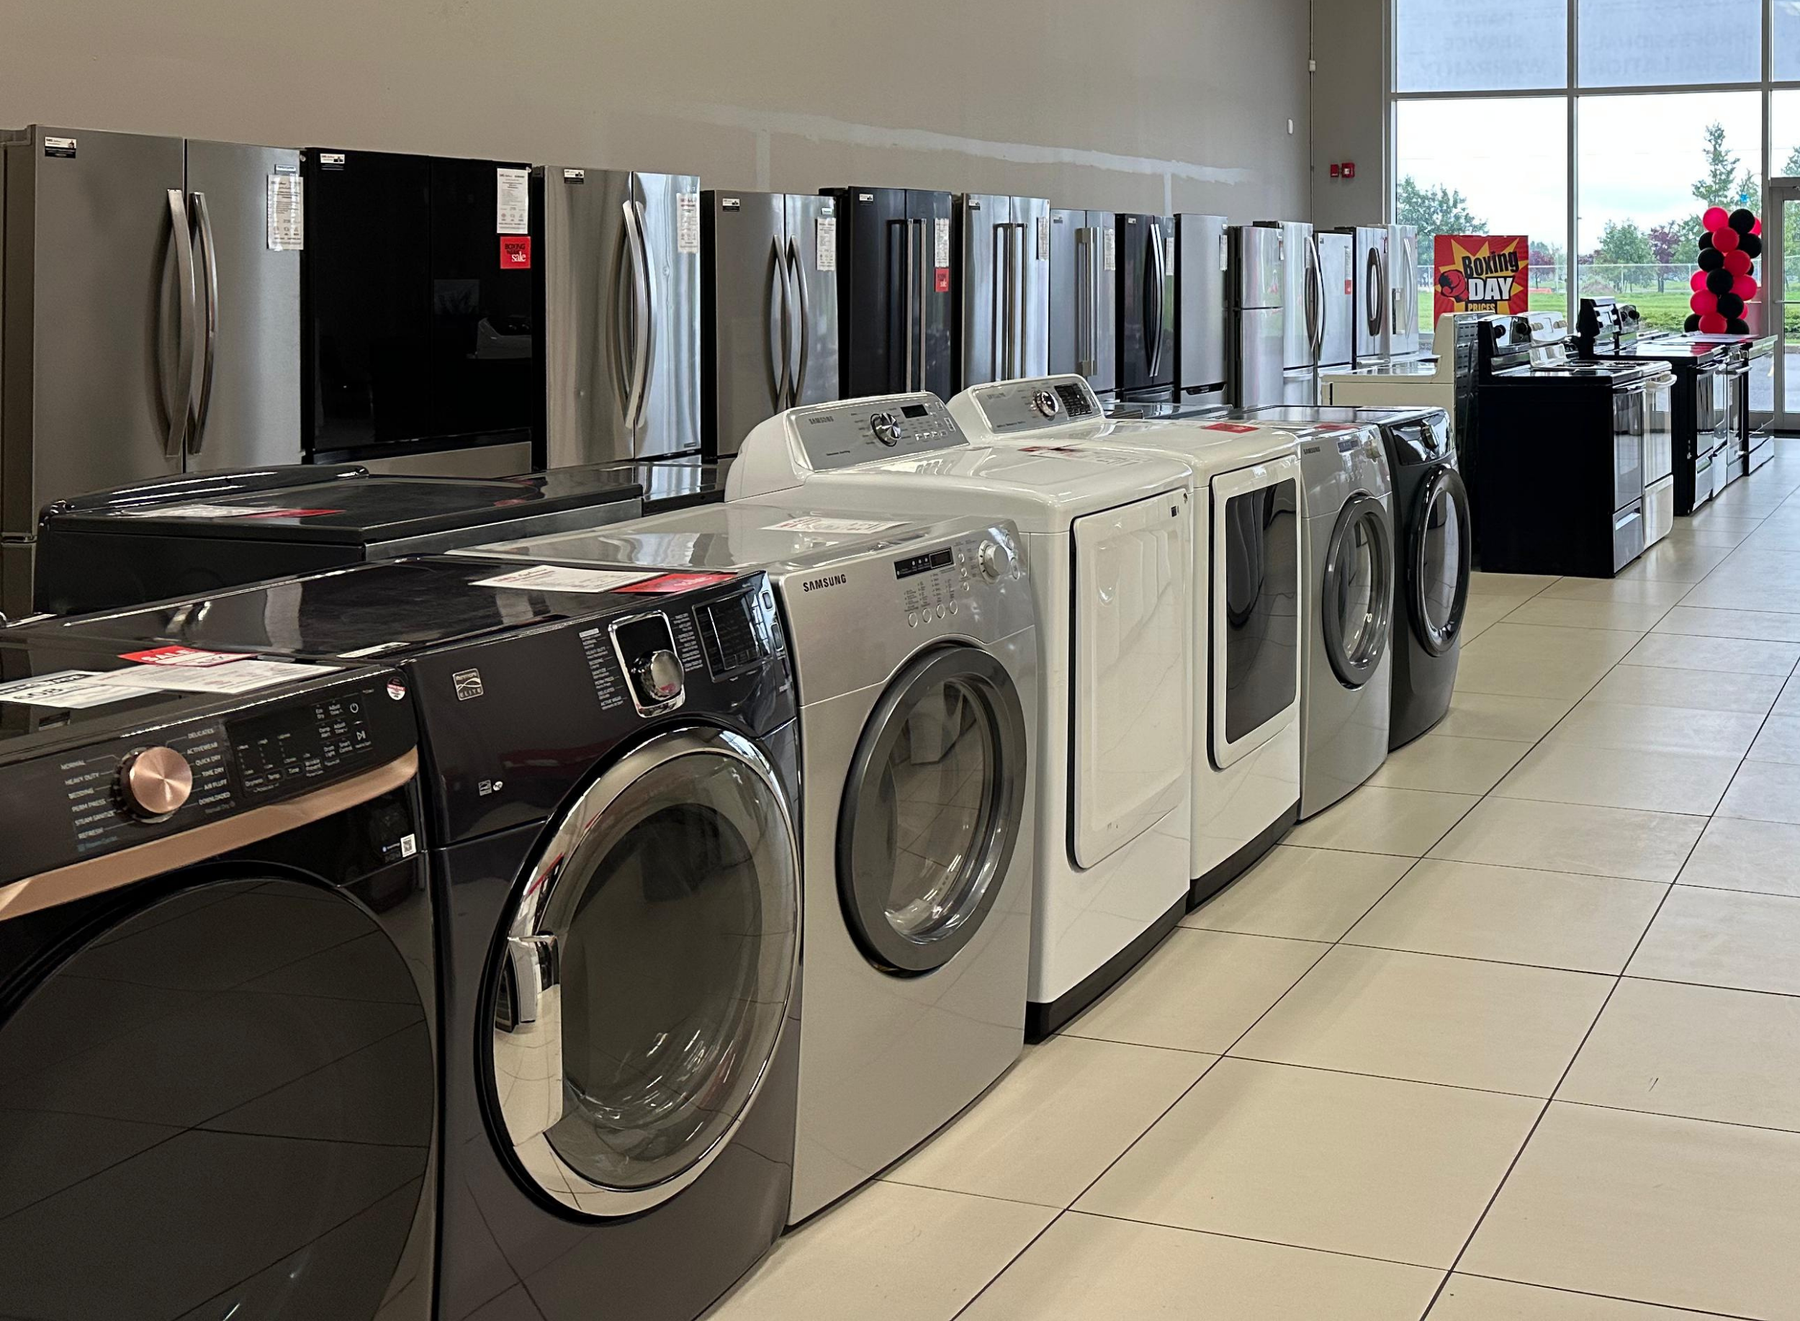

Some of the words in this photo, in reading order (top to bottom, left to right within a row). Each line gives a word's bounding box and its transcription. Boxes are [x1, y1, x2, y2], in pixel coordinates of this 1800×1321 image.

[511, 251, 527, 263] sale
[1461, 250, 1520, 278] Boxing
[1468, 277, 1514, 301] DAY
[1467, 303, 1496, 312] PRICES
[803, 573, 847, 593] SAMSUNG
[141, 650, 194, 662] SALE
[460, 687, 482, 698] ELITE
